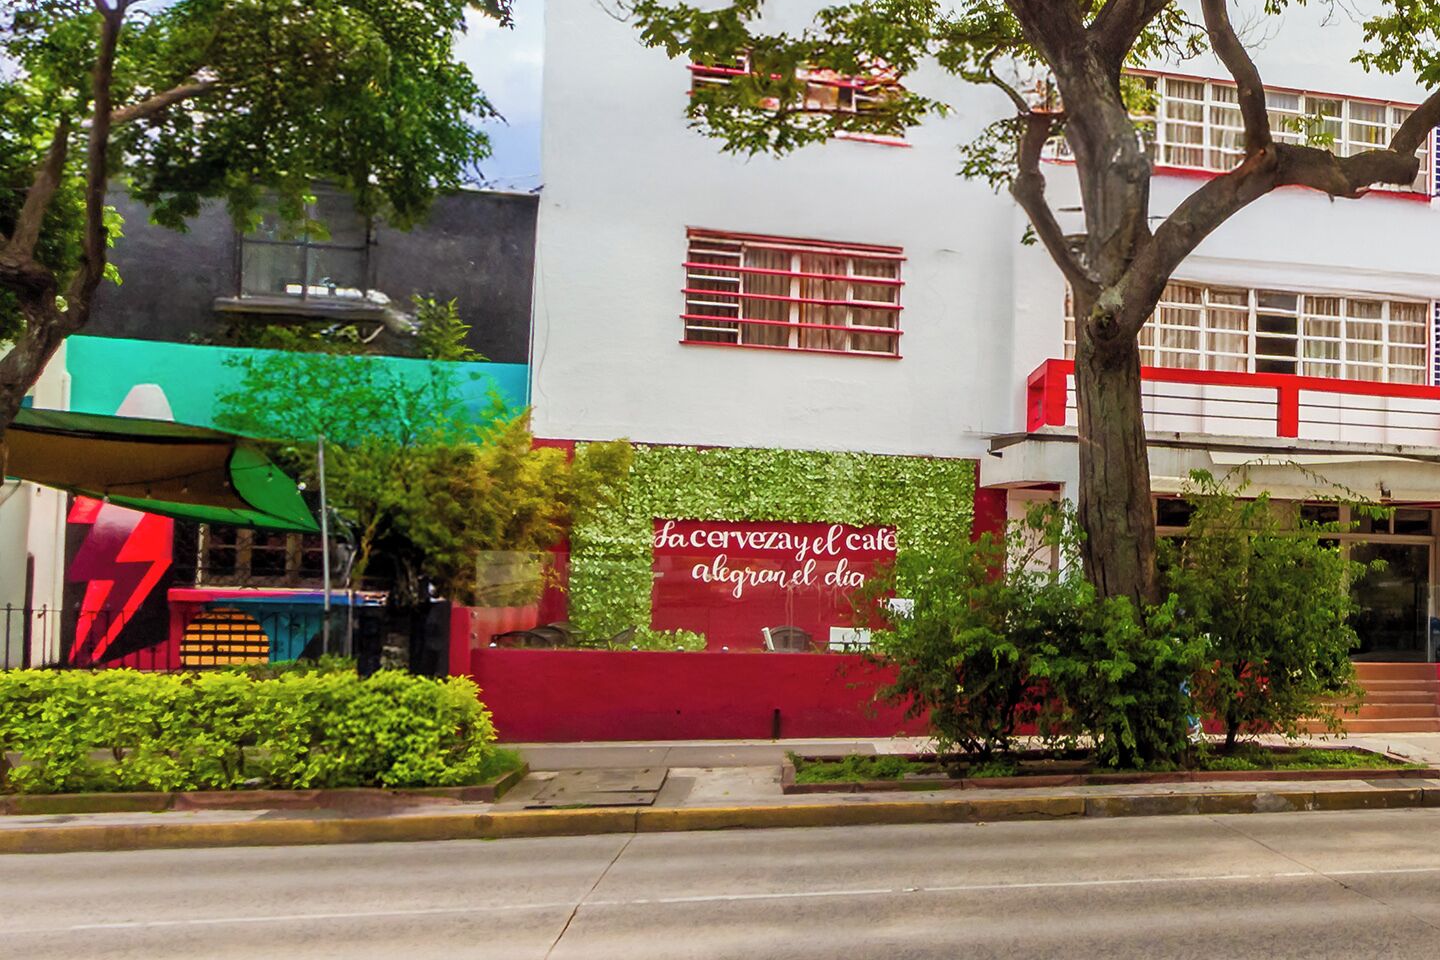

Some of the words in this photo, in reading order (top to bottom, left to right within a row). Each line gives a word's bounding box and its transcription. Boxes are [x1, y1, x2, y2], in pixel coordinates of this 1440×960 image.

[690, 529, 792, 550] cerveza
[794, 536, 811, 561] y
[812, 524, 843, 555] el
[846, 528, 897, 551] café
[692, 554, 788, 598] alegran
[792, 558, 817, 586] el
